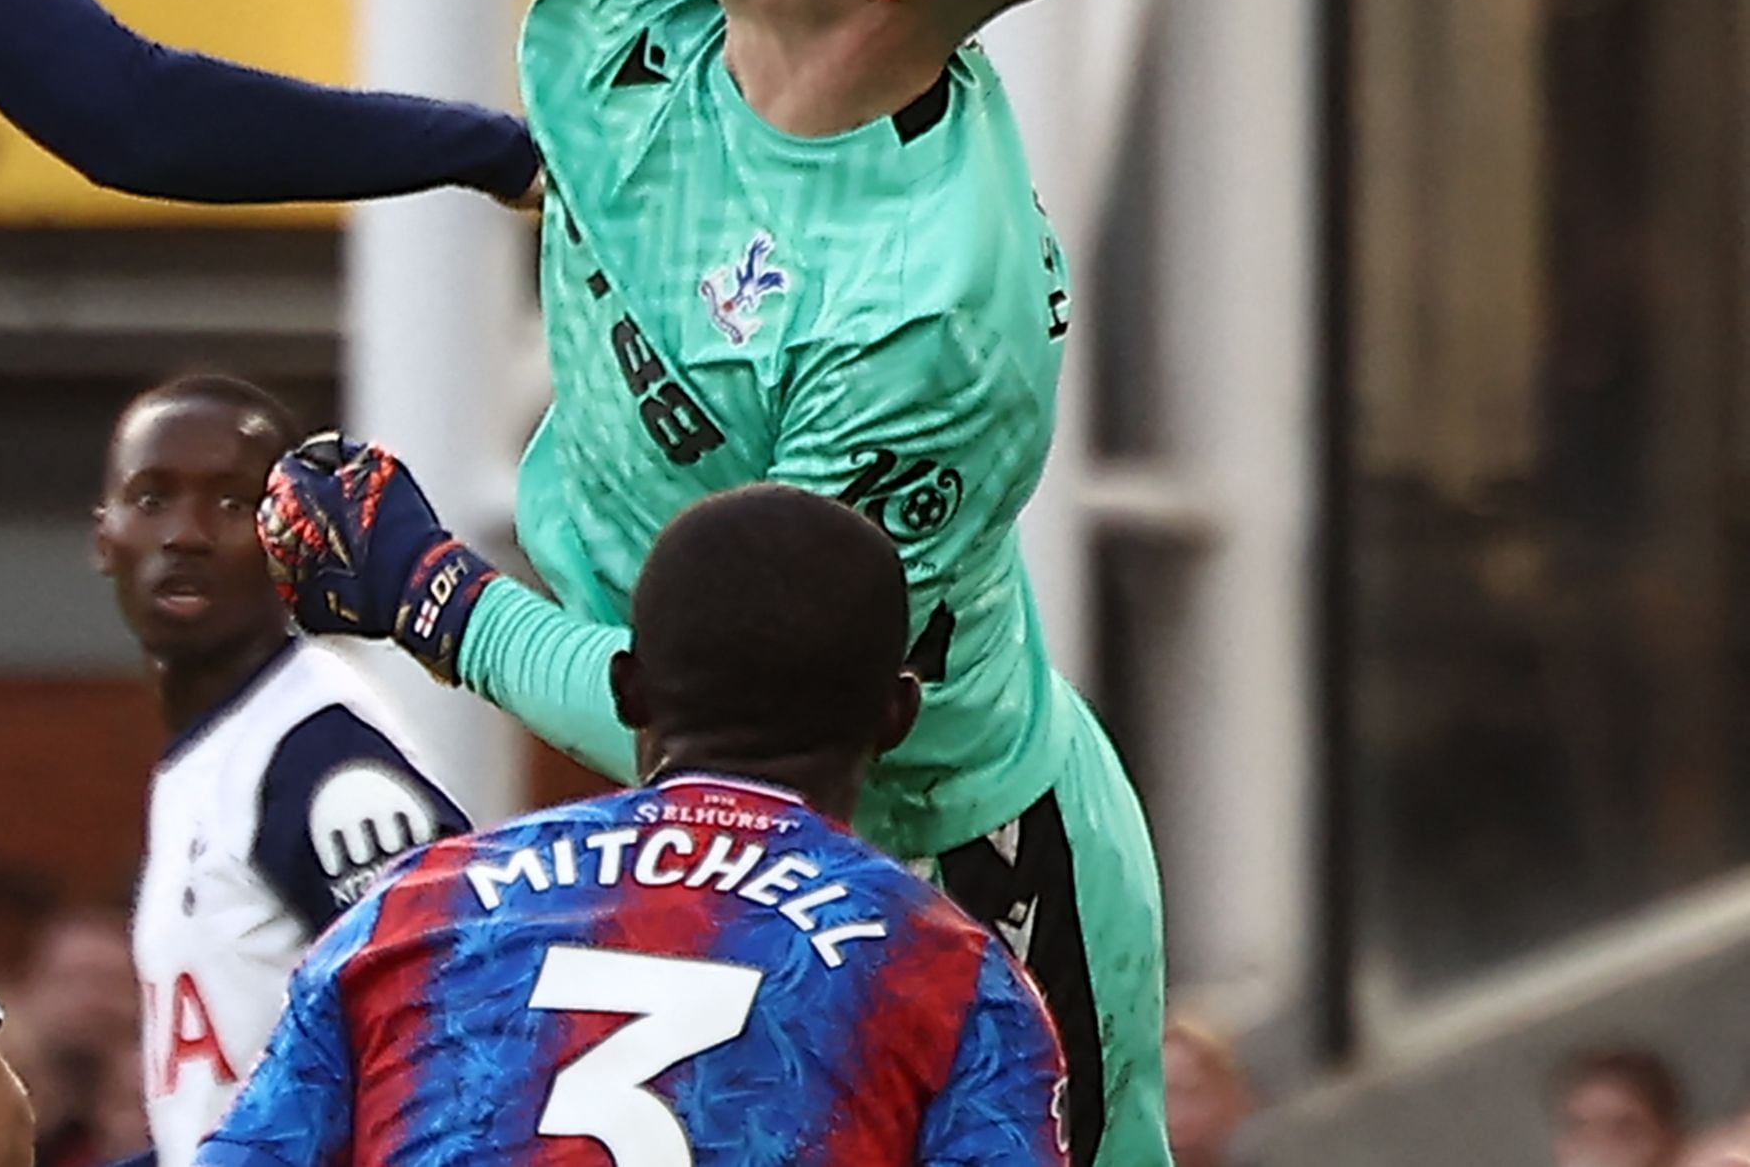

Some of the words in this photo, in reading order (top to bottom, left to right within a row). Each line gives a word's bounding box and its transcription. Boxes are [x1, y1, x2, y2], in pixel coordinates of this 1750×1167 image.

[430, 556, 469, 606] DH
[633, 802, 801, 834] SELHURST
[466, 828, 887, 969] MITCHELL
[527, 944, 766, 1167] 3
